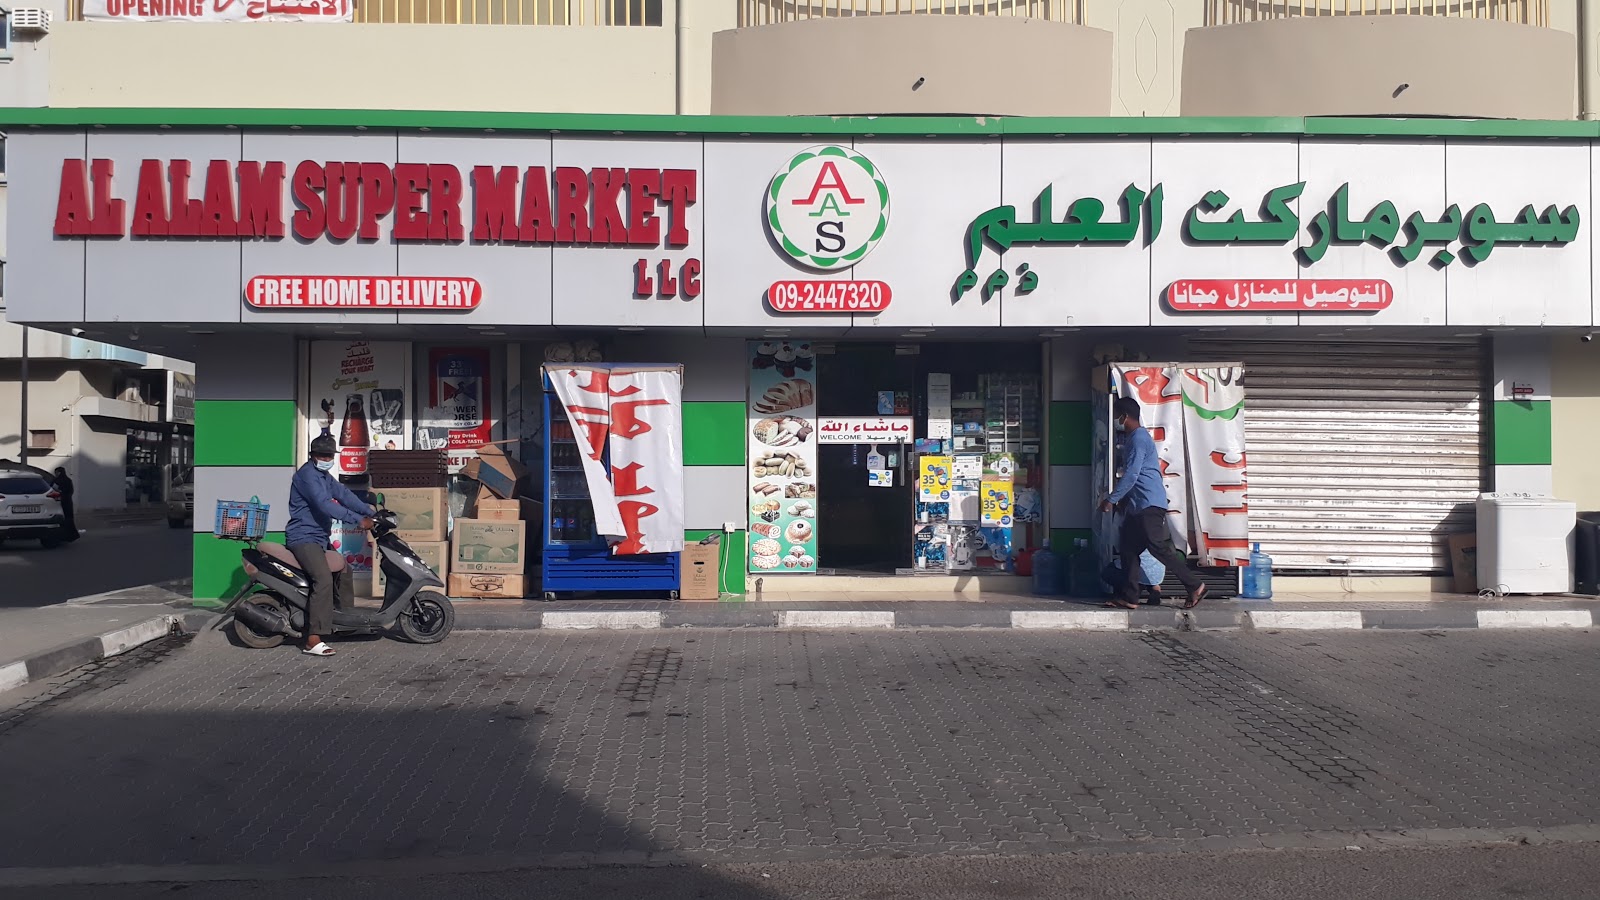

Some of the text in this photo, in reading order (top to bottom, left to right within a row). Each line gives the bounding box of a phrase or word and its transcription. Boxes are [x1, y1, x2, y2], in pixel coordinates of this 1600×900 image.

[106, 0, 204, 17] OPENING
[54, 158, 697, 246] AL ALAM SUPER MARKET
[635, 257, 701, 298] LLC
[253, 278, 476, 307] FREE HOME DELIVERY
[775, 282, 882, 310] 09-2447320
[1173, 282, 1387, 308] التوصيل للمنازل مجانا
[341, 356, 374, 368] RECHARGE
[341, 364, 375, 375] YOUR HEART
[922, 474, 935, 484] 35
[983, 500, 996, 510] 35
